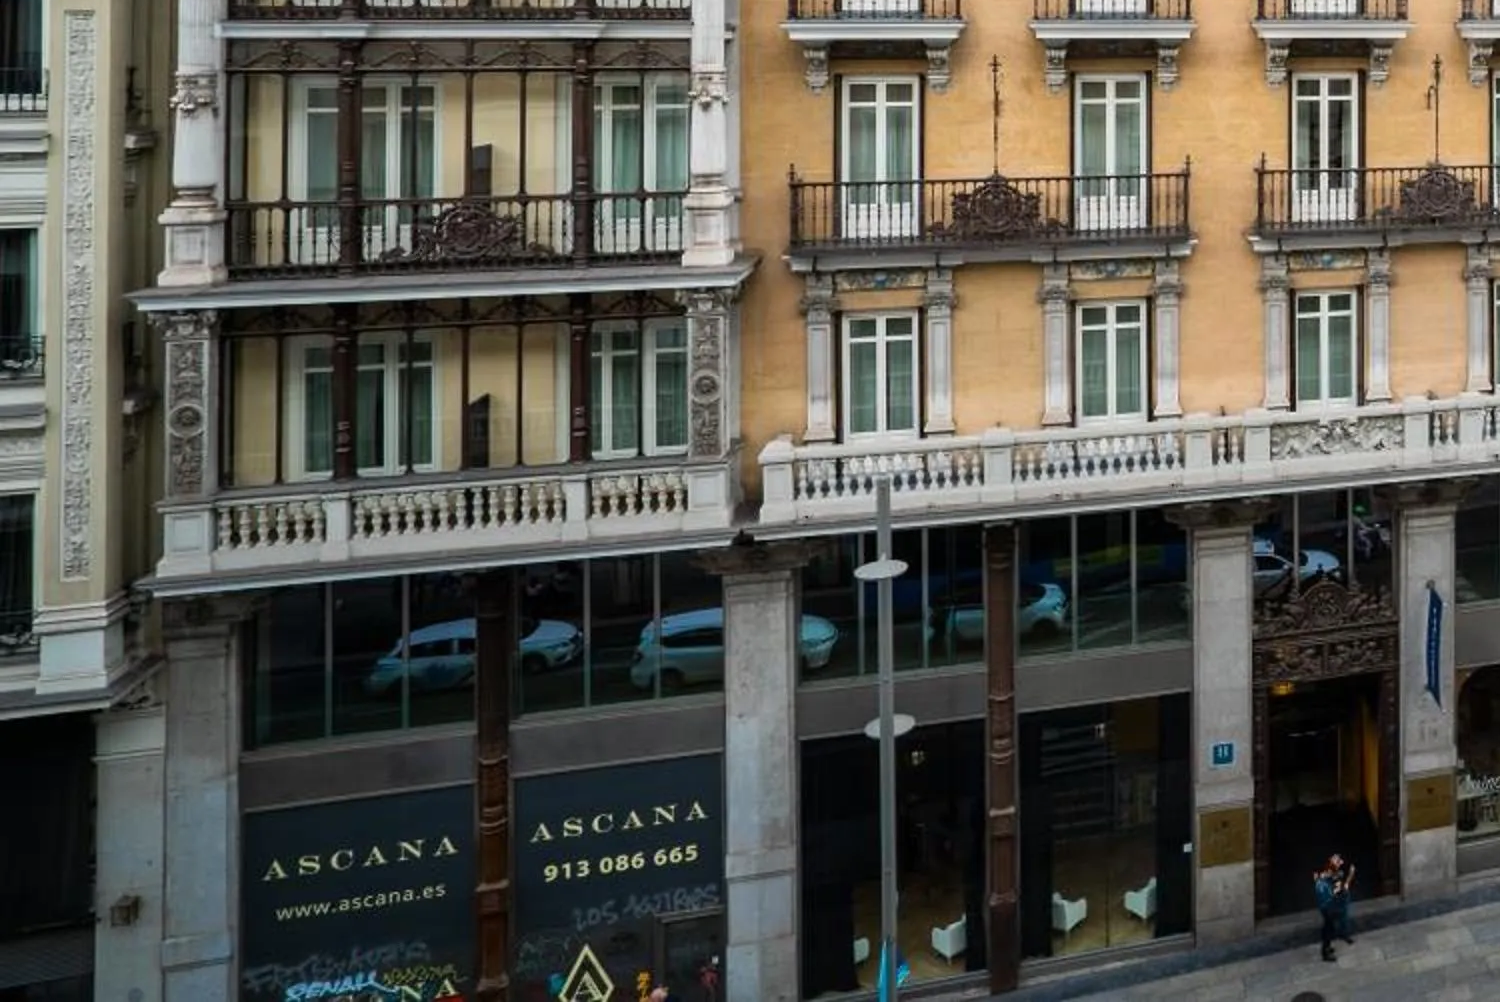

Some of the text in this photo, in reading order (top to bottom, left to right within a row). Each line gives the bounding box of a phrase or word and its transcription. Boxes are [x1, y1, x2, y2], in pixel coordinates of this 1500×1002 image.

[529, 800, 710, 843] ASCANA
[261, 835, 459, 881] ASCANA
[543, 844, 699, 883] 913 086 665
[275, 883, 447, 922] www.ascana.es
